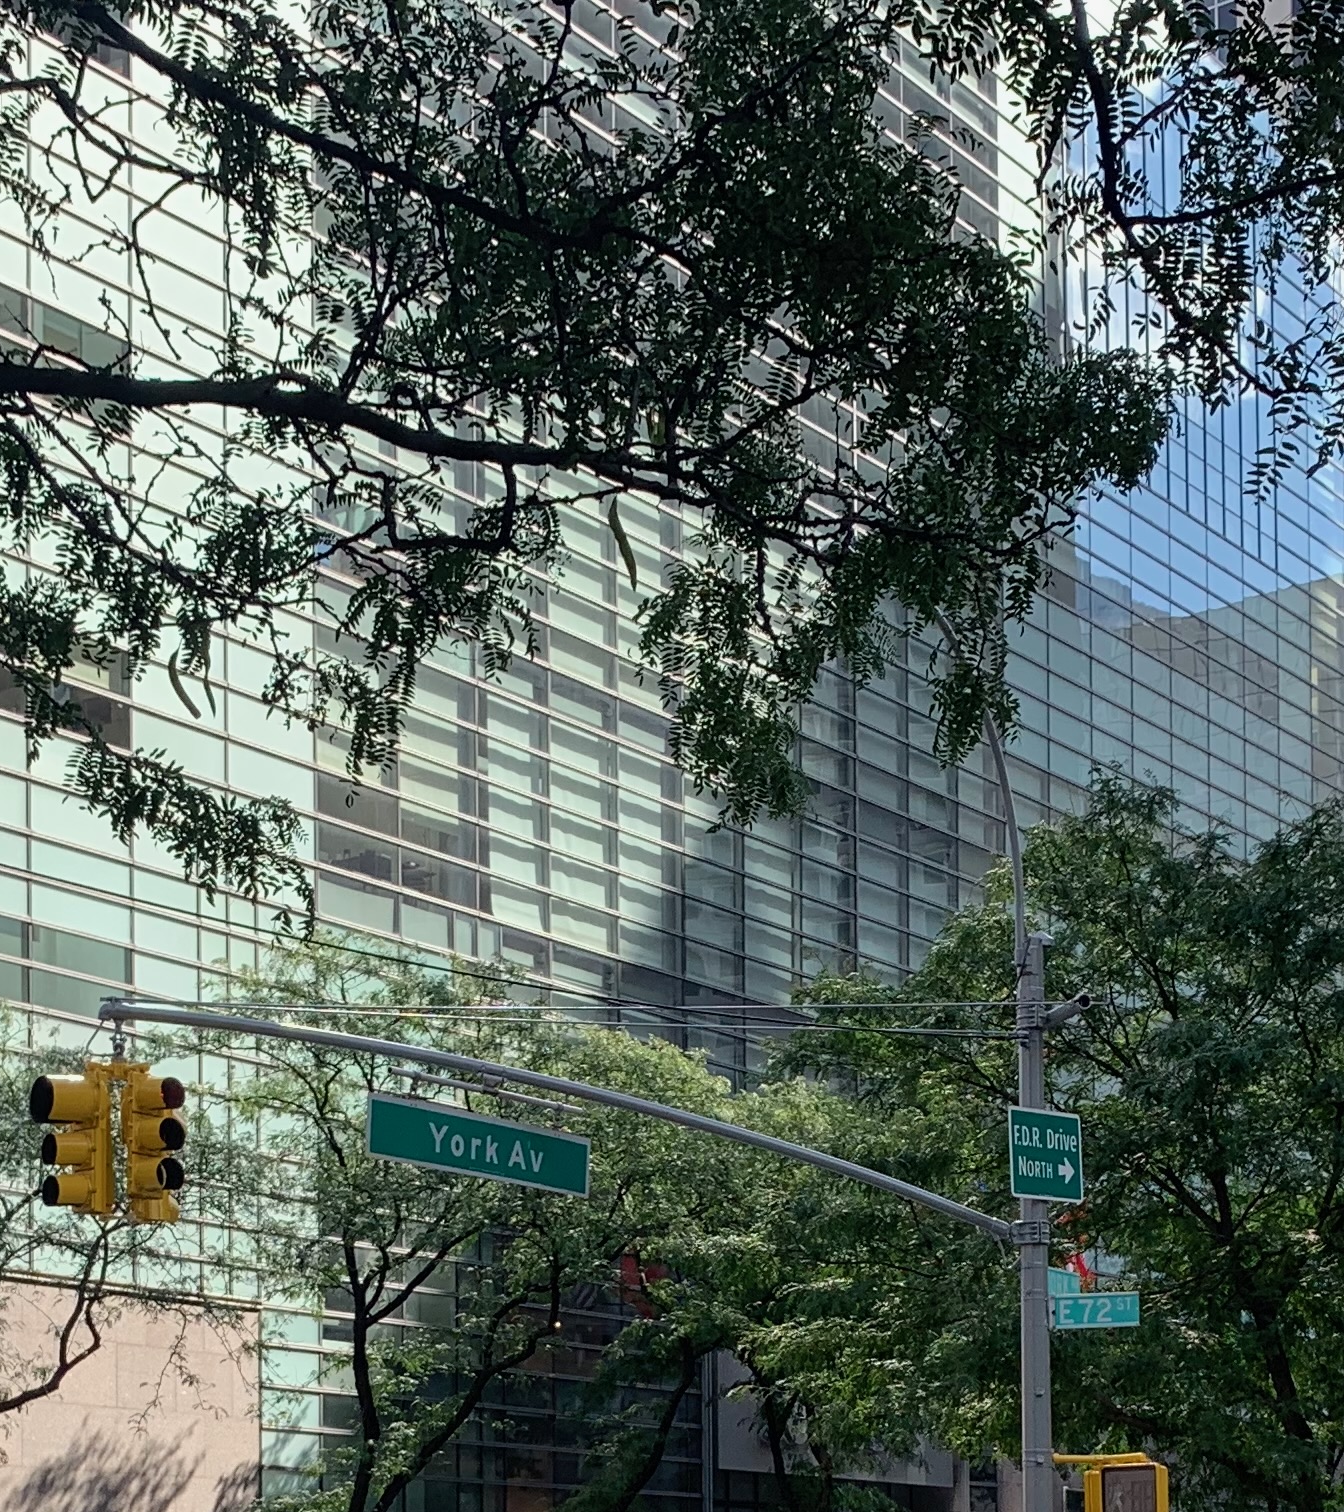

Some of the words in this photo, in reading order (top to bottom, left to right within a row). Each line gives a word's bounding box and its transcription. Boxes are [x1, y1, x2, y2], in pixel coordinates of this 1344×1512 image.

[429, 1122, 498, 1165] York
[508, 1140, 544, 1173] Av
[1014, 1125, 1043, 1148] F.D.R.
[1046, 1128, 1077, 1152] Drive
[1018, 1155, 1053, 1179] NORTH
[1058, 1299, 1074, 1324] E
[1078, 1298, 1112, 1323] 72
[1116, 1297, 1131, 1310] ST
